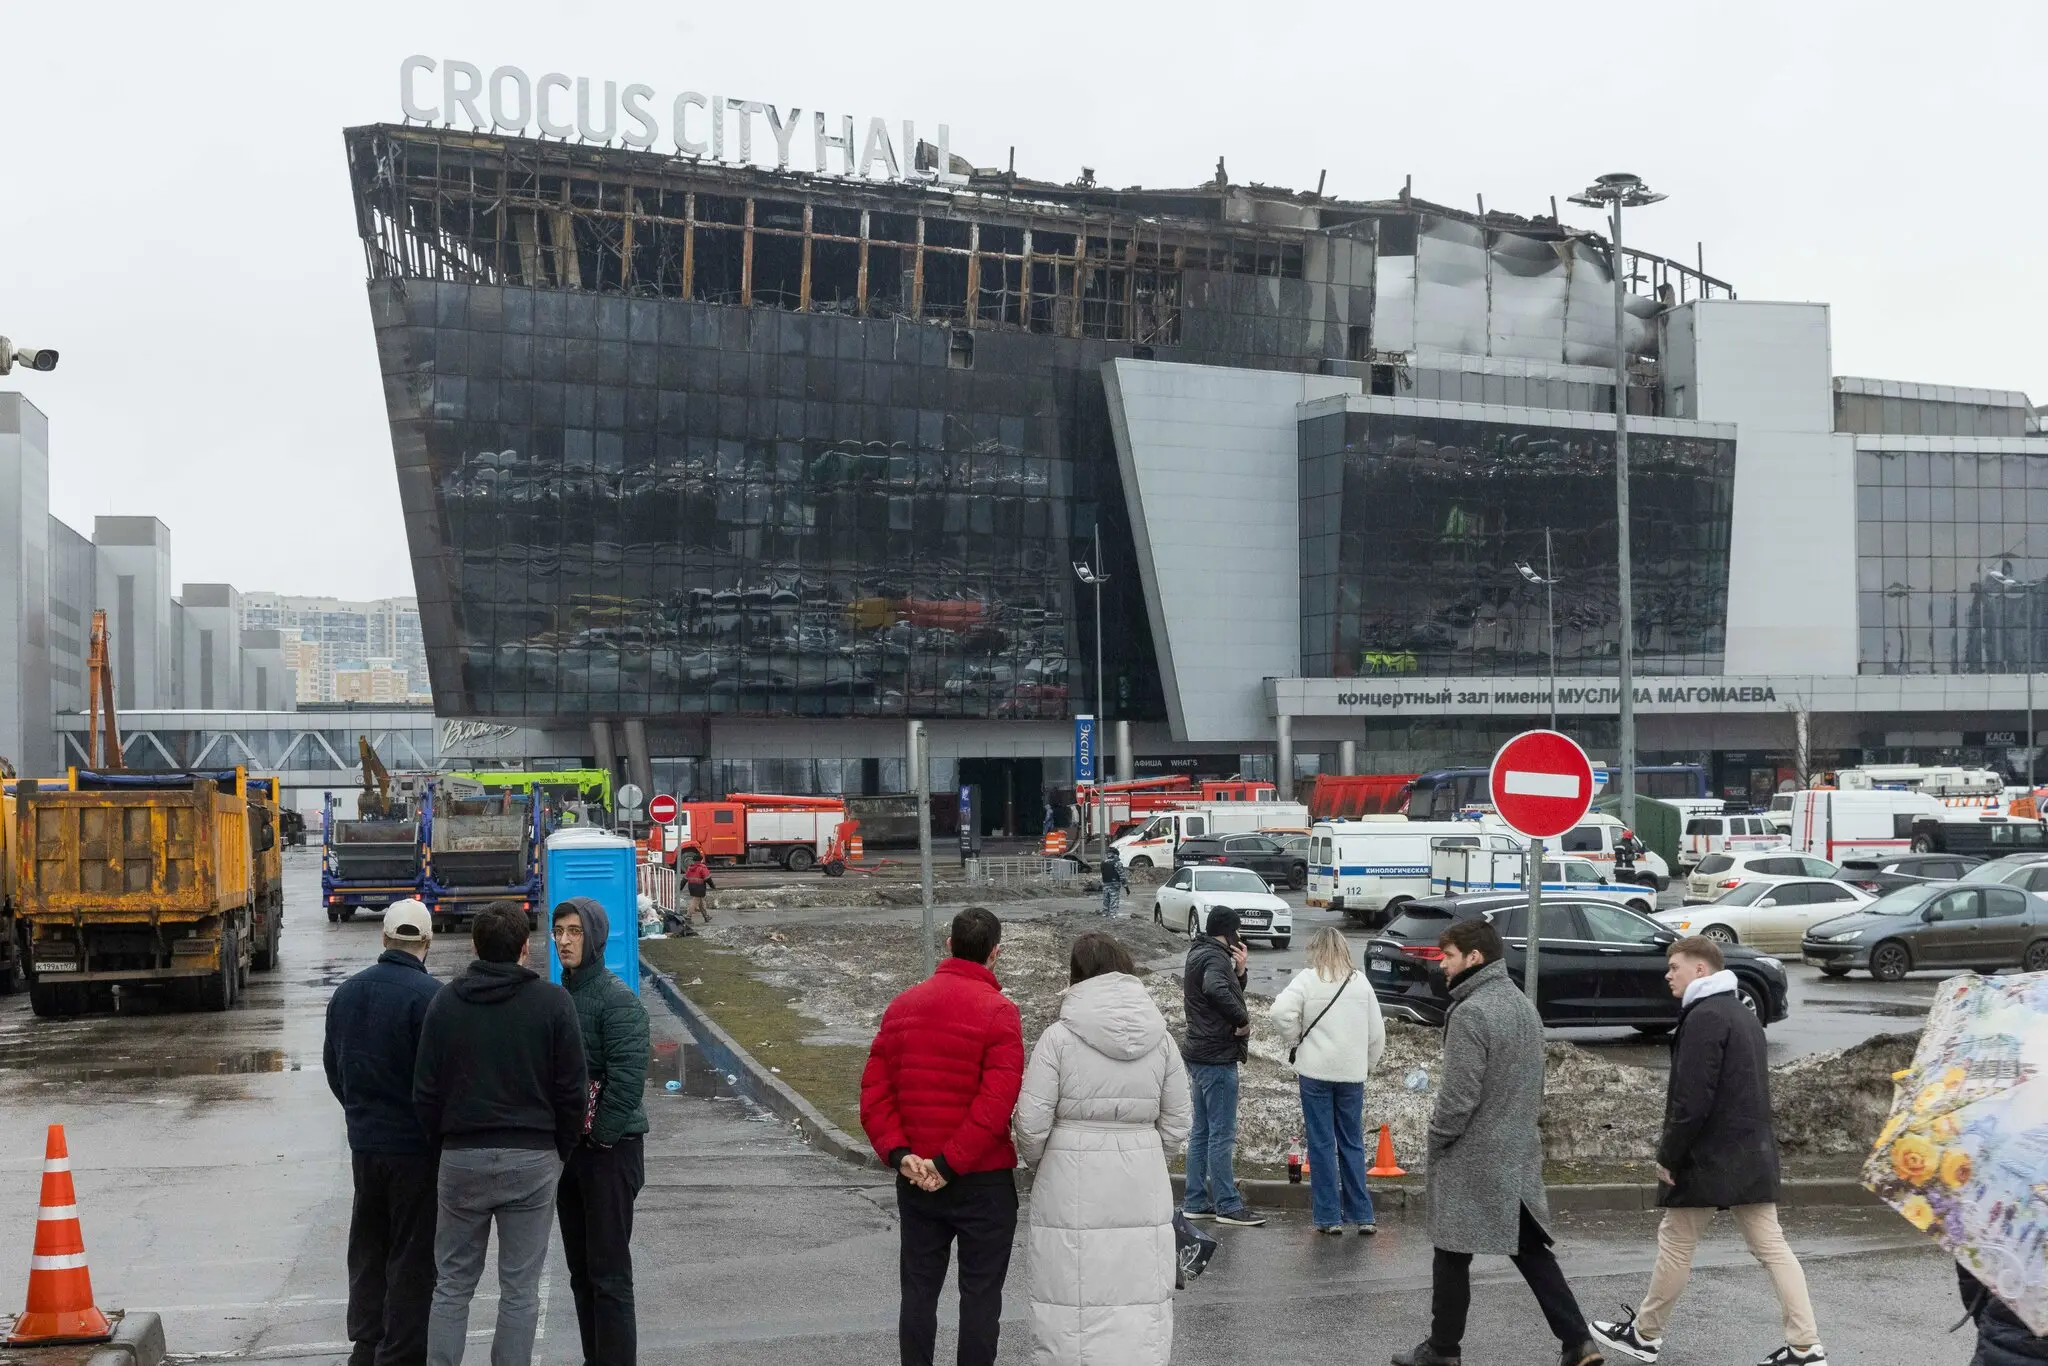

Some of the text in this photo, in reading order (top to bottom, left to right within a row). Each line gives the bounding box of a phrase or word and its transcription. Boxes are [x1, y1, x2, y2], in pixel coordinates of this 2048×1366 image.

[400, 55, 970, 186] CROCUS CITY HALL
[1337, 688, 1451, 708] концертный
[1457, 691, 1489, 704] зал
[1494, 691, 1552, 704] имени
[1658, 687, 1777, 703] МАГОМАЕВА
[1986, 731, 2016, 742] КАССА
[1346, 886, 1362, 895] 112
